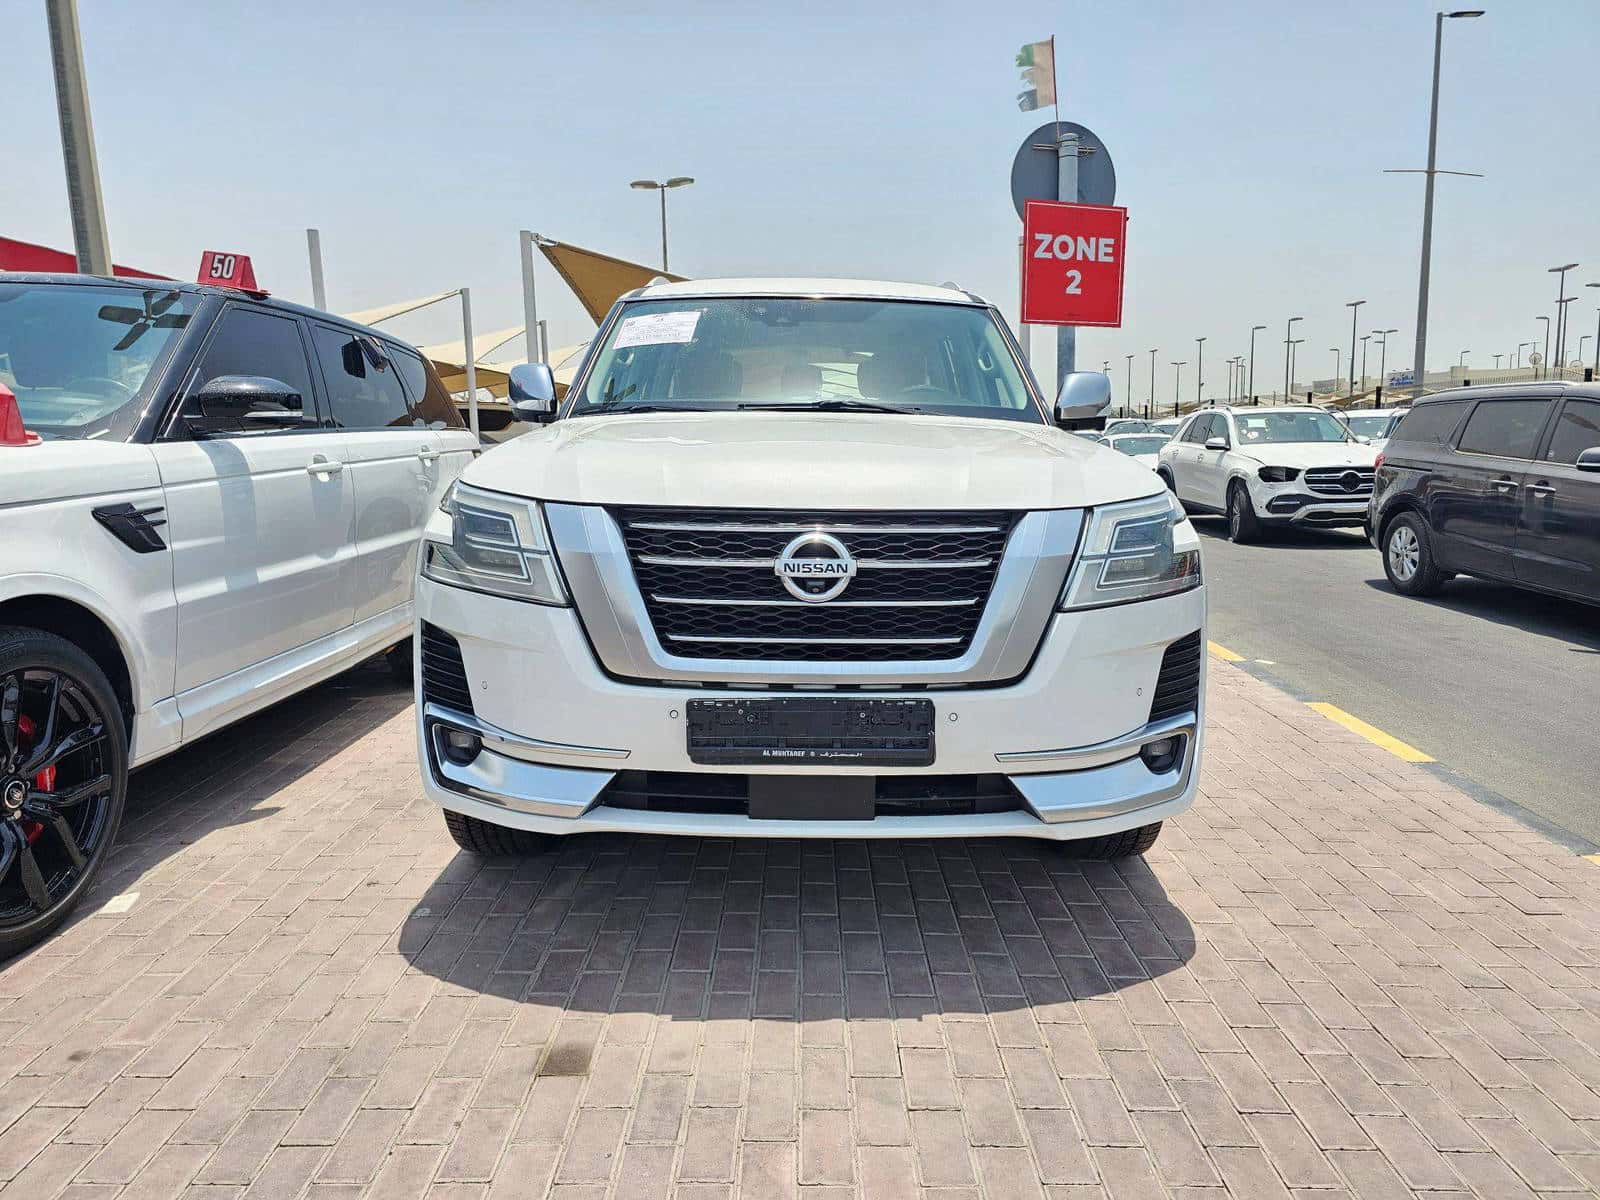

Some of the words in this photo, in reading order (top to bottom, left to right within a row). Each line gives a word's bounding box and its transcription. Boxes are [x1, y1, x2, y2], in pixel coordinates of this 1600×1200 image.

[1033, 232, 1115, 263] ZONE
[210, 254, 236, 279] 50
[1065, 269, 1082, 295] 2
[783, 562, 848, 574] NISSAN
[762, 749, 771, 757] AL
